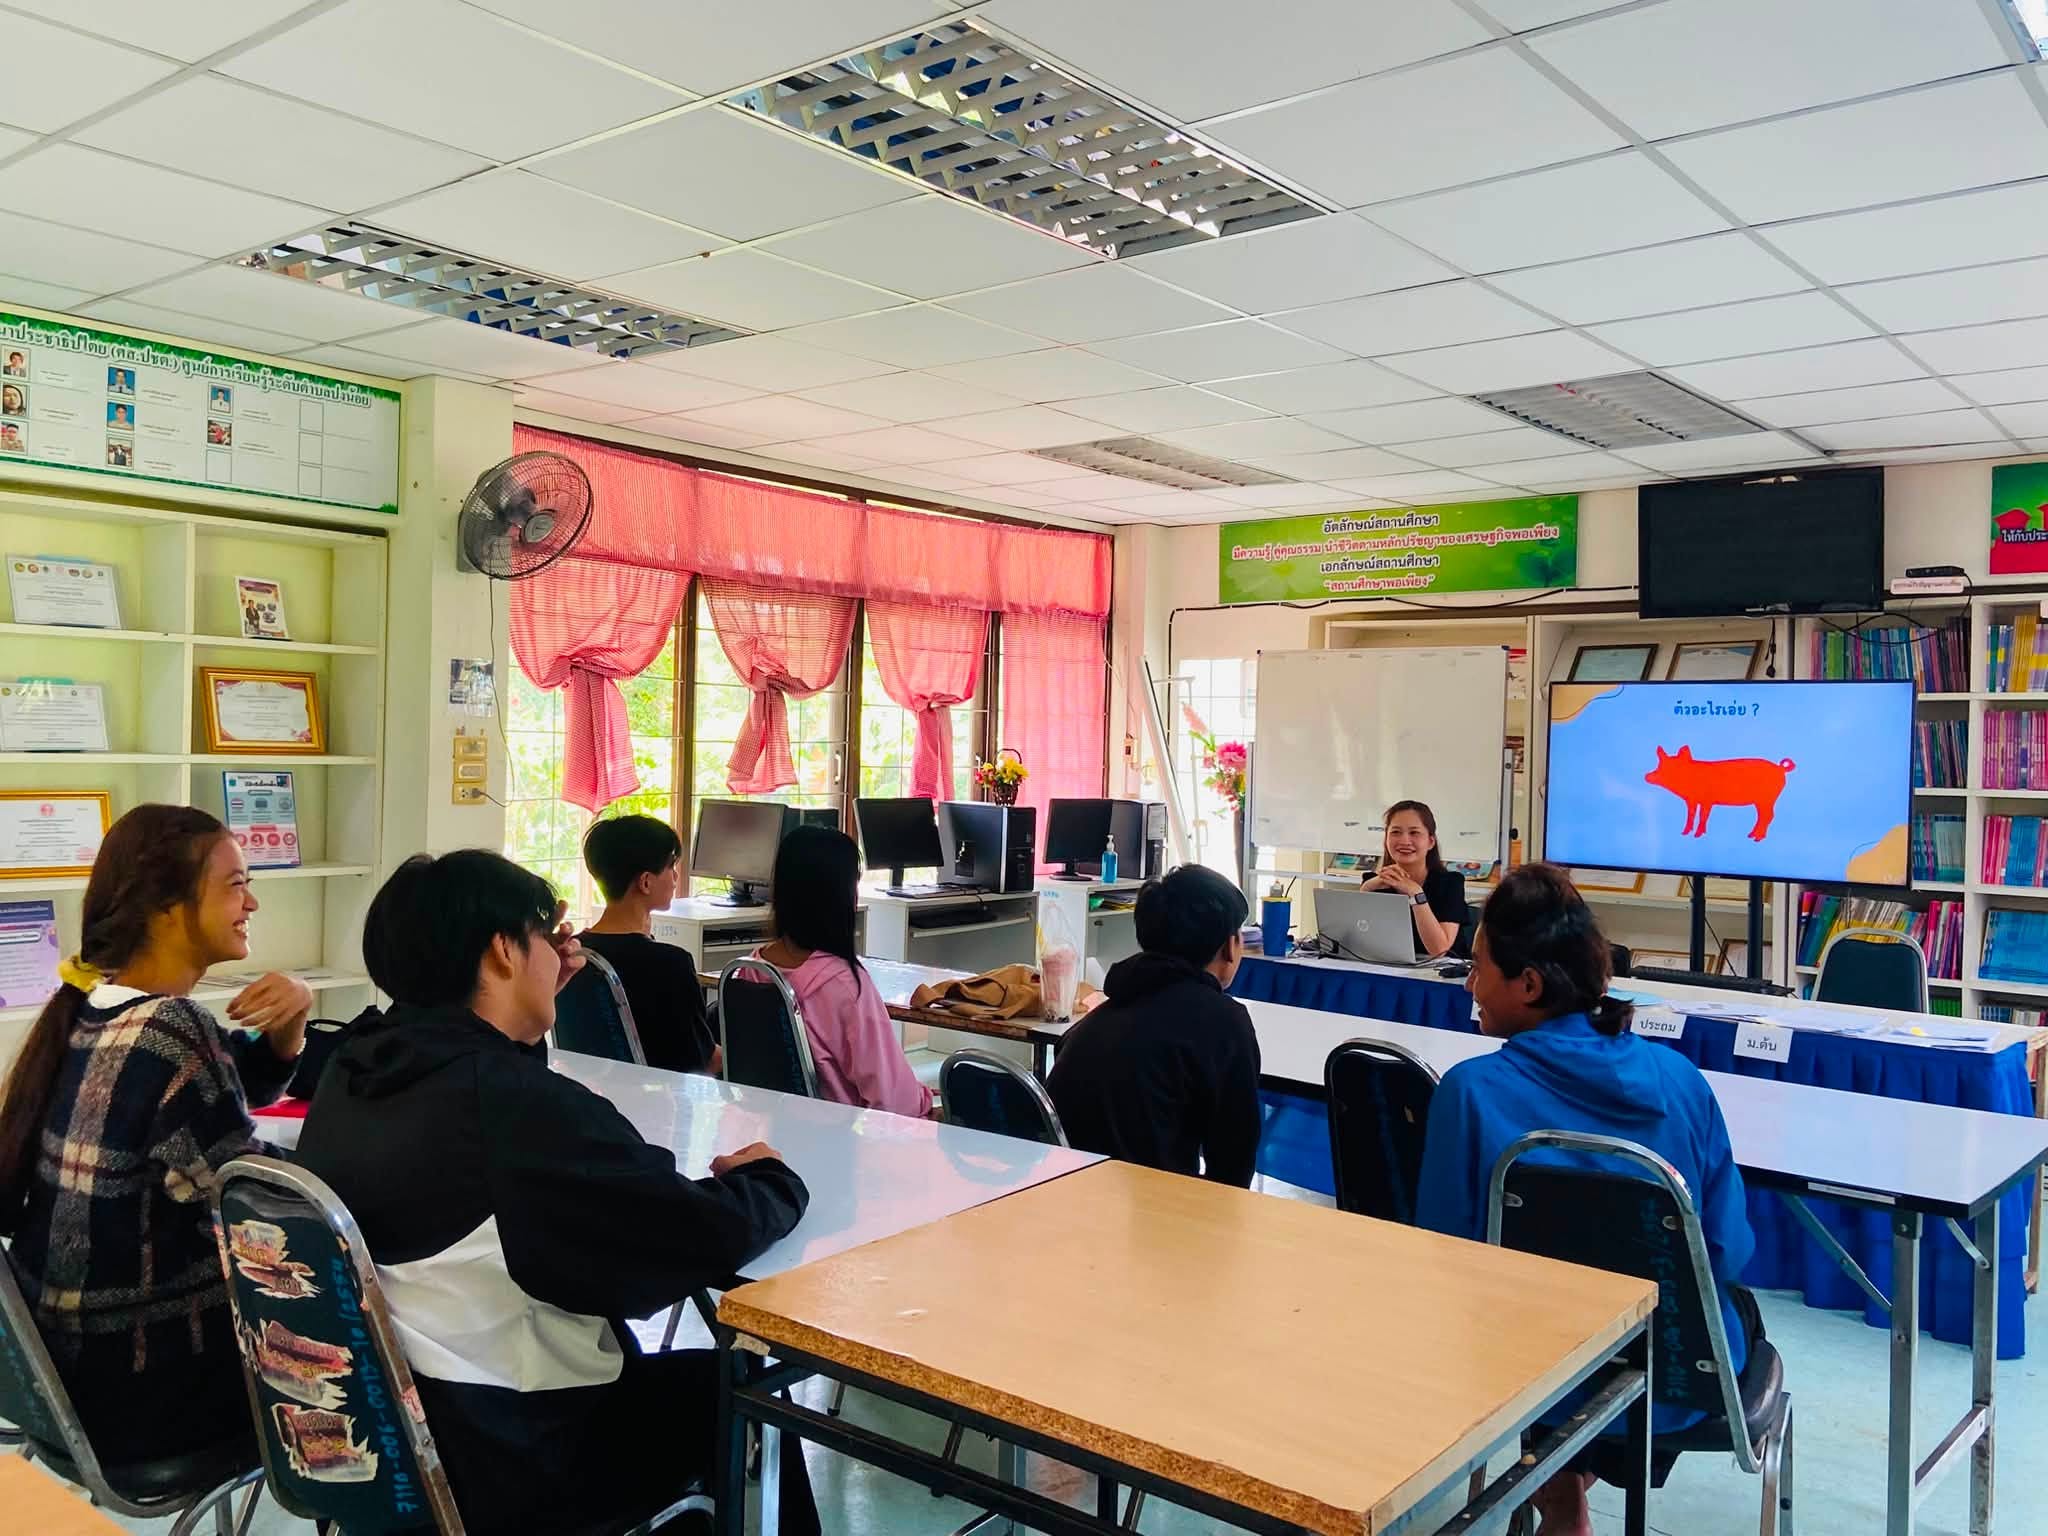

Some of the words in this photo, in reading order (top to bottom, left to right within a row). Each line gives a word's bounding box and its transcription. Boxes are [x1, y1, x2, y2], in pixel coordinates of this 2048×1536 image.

[1324, 511, 1439, 533] อัตลักษณ์สถานศึกษา
[1233, 543, 1271, 560] มีความรู้
[1321, 554, 1439, 573] เอกลักษณ์สถานศึกษา
[1674, 700, 1746, 716] ตัวอะไรเอ่ย
[1752, 703, 1760, 716] ?
[1640, 1018, 1676, 1033] ประถม
[1746, 1037, 1777, 1052] ม.ต้น
